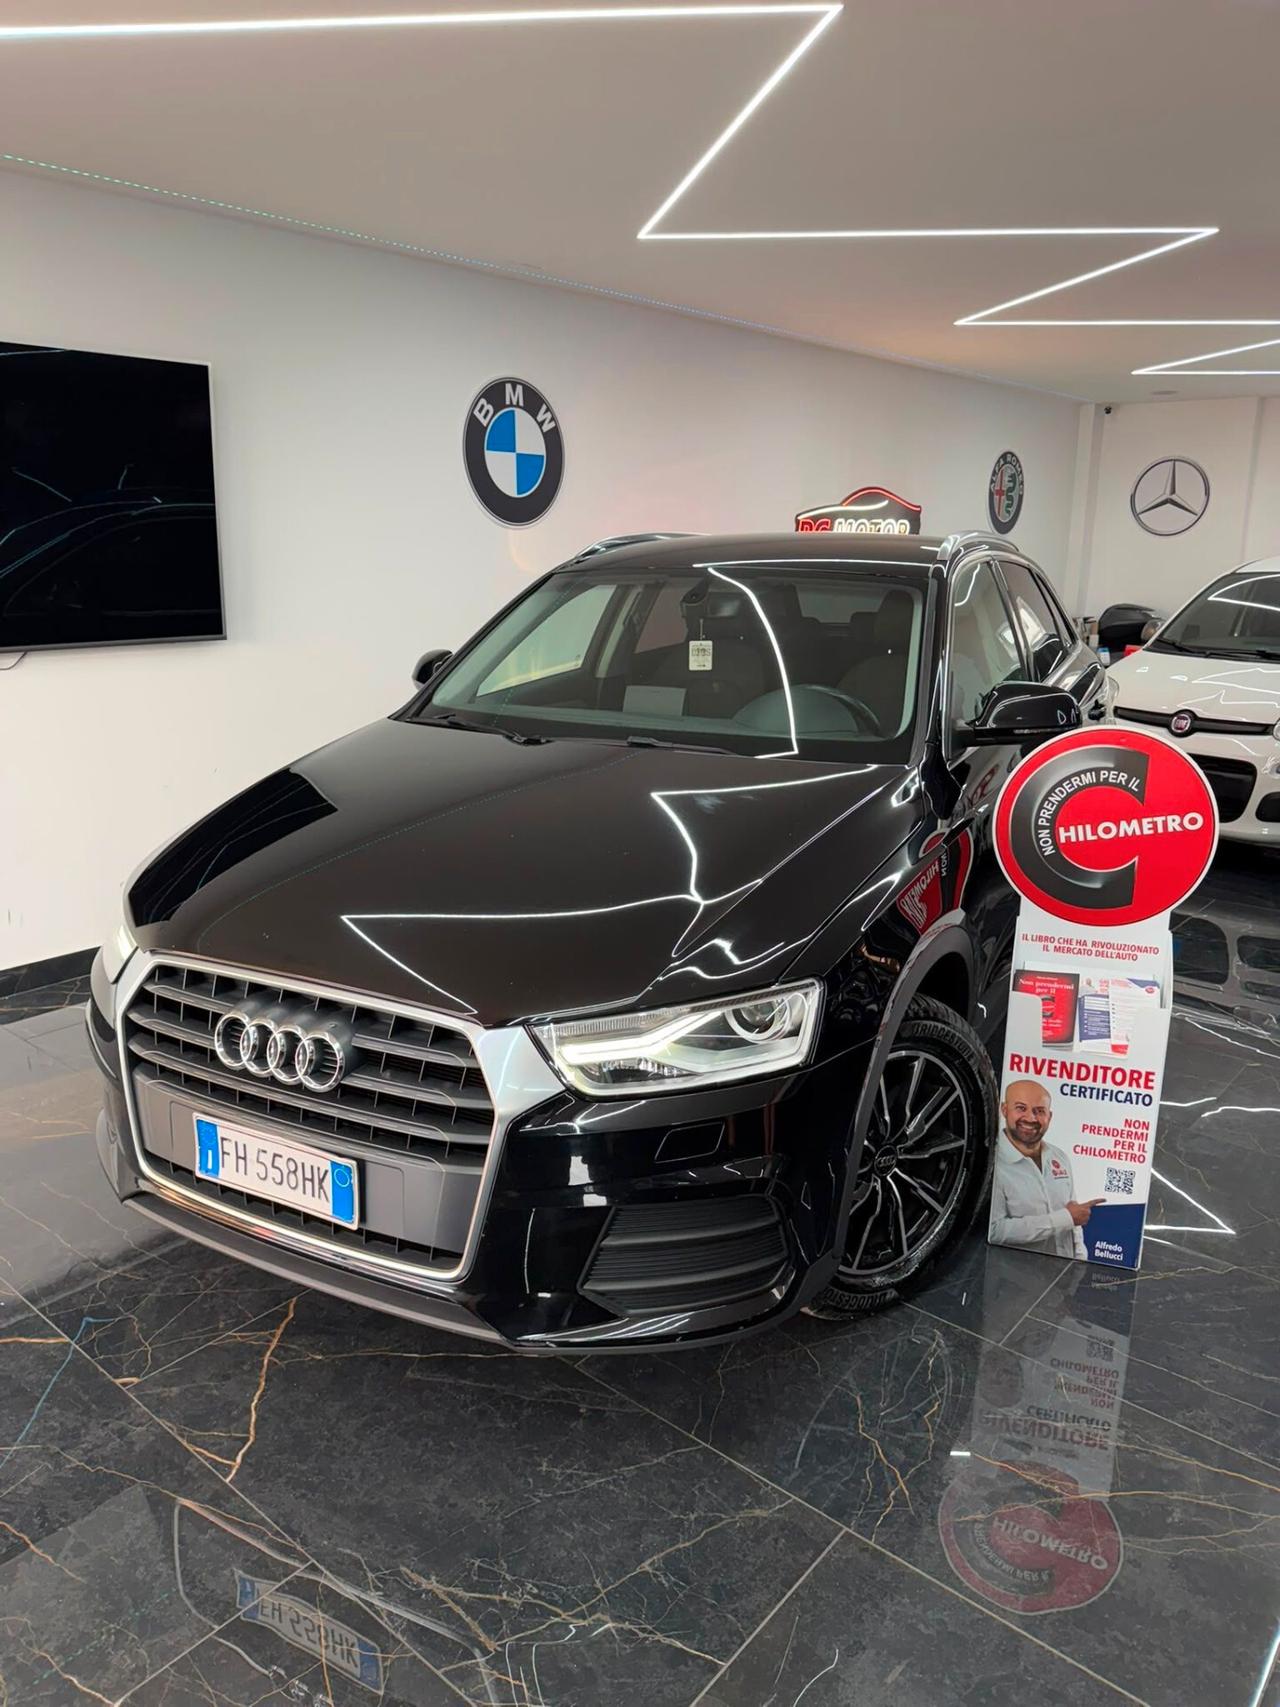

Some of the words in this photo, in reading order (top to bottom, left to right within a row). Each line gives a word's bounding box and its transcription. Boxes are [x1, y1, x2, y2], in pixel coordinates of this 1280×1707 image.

[473, 382, 556, 433] BMW
[833, 518, 911, 535] MOTOR
[1101, 770, 1128, 786] PER
[1127, 778, 1142, 792] IL
[1038, 771, 1097, 825] PRENDERMI
[1038, 827, 1056, 856] NON
[1022, 934, 1031, 942] IL
[1031, 935, 1056, 944] LIBRO
[1057, 937, 1074, 946] CHE
[1075, 939, 1088, 947] HA
[1091, 940, 1160, 955] RIVOLUZIONATO
[1042, 944, 1050, 953] IL
[1053, 945, 1093, 957] MERCATO
[1094, 949, 1138, 962] DELL'AUTO
[1009, 1053, 1156, 1090] RIVENDITORE
[1060, 1083, 1153, 1107] CERTIFICATO
[1081, 1124, 1149, 1142] PRENDERMI
[1124, 1118, 1150, 1132] NON
[1073, 1144, 1147, 1164] CHILOMETRO
[1113, 1139, 1137, 1152] PER
[1138, 1142, 1147, 1153] IL
[220, 1136, 248, 1176] FH
[256, 1147, 330, 1202] 558HK
[1094, 1249, 1123, 1262] Bellucci
[1095, 1240, 1123, 1253] Alfredo
